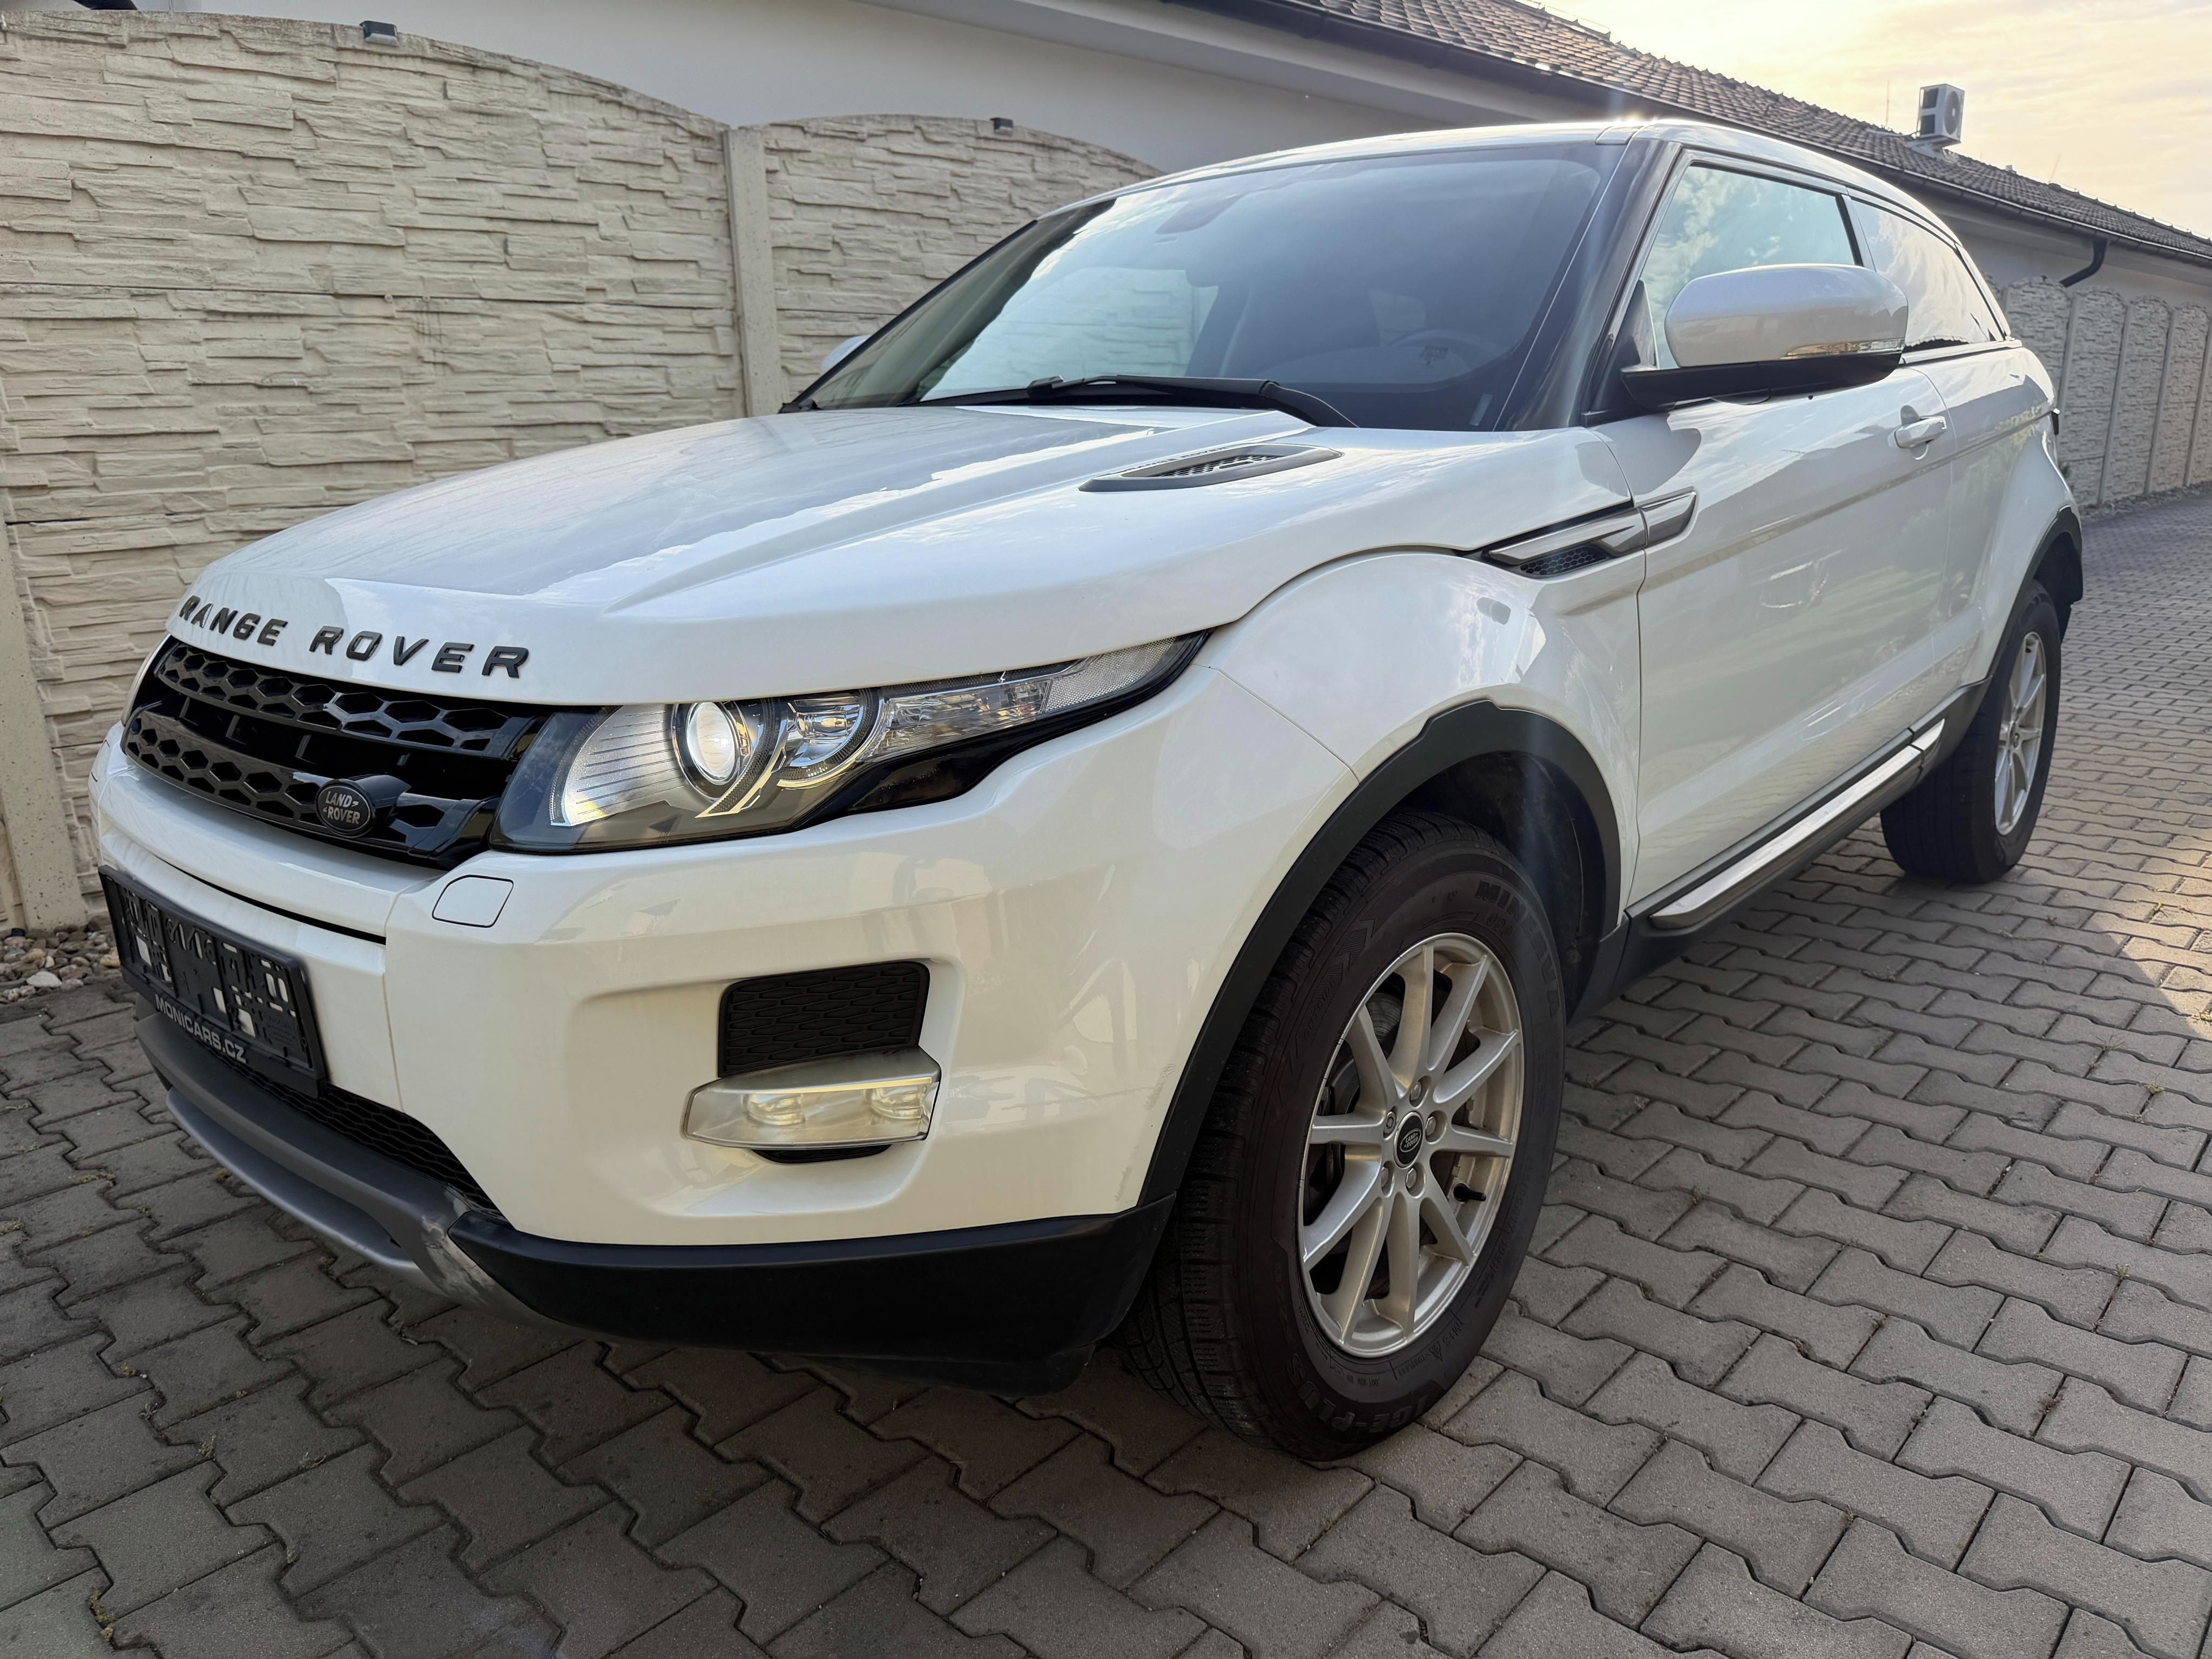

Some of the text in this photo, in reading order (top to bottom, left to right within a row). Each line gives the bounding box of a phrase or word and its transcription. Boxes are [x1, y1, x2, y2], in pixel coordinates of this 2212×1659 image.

[178, 595, 530, 679] RANGE ROVER
[325, 791, 353, 808] LAND
[327, 806, 361, 825] ROVER
[1474, 880, 1560, 1019] MINERVA
[154, 994, 247, 1064] MONICARS.CZ
[1285, 1353, 1428, 1434] ICE-PLUS
